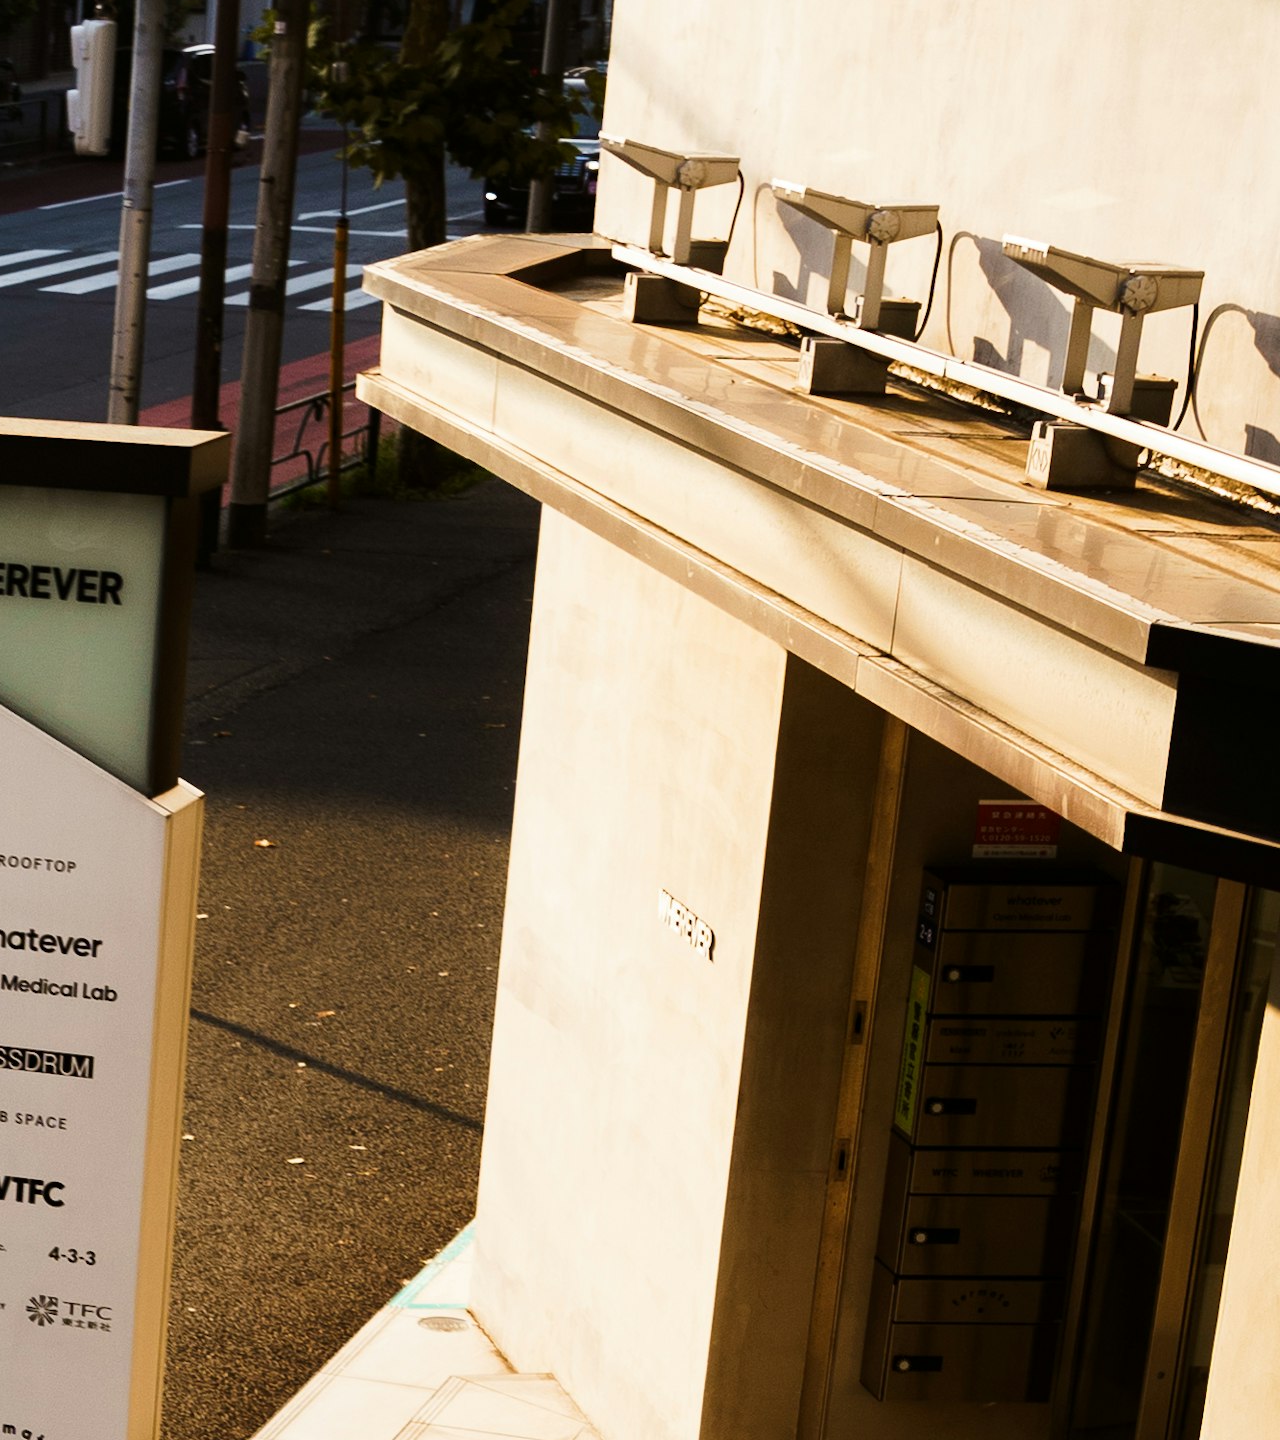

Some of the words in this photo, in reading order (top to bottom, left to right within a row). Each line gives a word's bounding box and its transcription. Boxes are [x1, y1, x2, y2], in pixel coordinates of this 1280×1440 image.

[1007, 894, 1062, 906] whatever
[0, 972, 78, 998] Medical
[81, 979, 118, 1003] Lab
[14, 1109, 68, 1131] SPACE
[47, 1246, 97, 1266] 4-3-3
[62, 1300, 113, 1321] TFC
